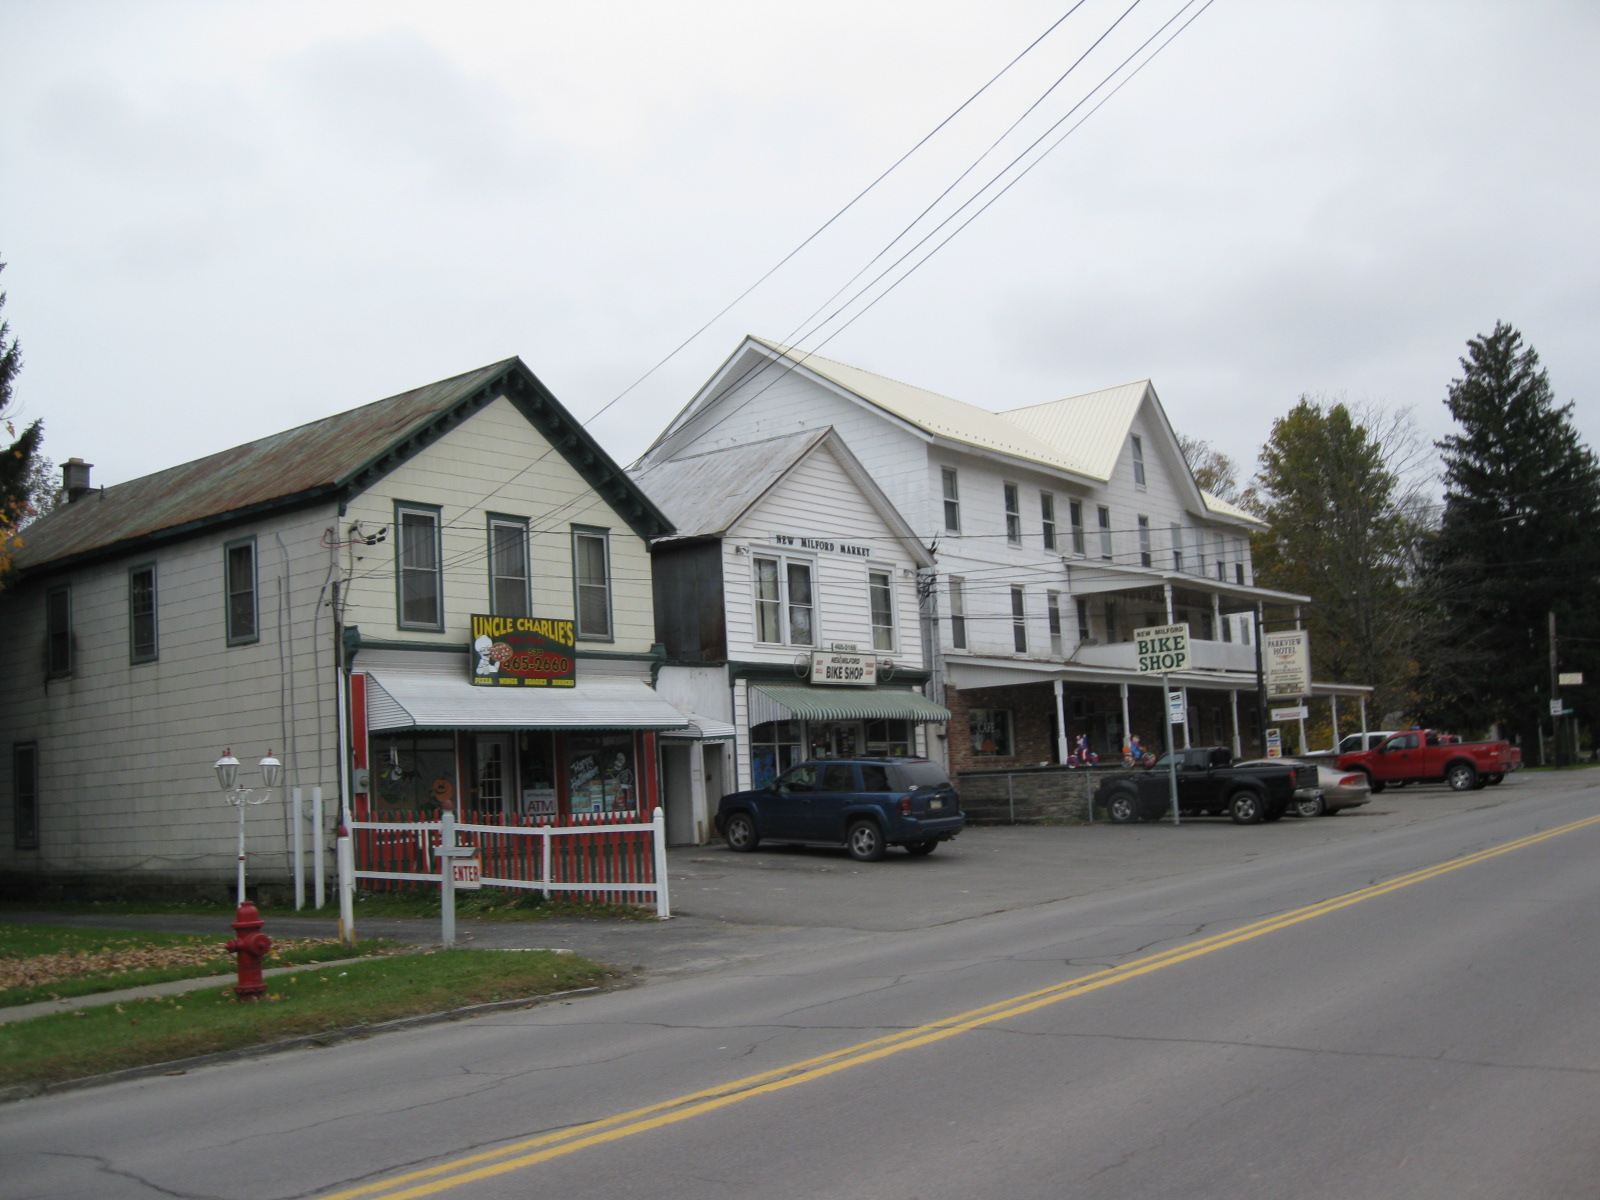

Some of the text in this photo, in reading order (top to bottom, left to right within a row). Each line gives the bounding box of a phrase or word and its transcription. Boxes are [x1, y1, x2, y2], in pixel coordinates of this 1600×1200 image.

[776, 535, 870, 557] NEW MILFORD MARKET
[473, 616, 574, 647] UNCLE CHARLIE'S
[1136, 626, 1184, 638] NEW MILFORD
[1137, 635, 1185, 655] BIKE
[1267, 638, 1302, 648] PARKVIEW
[1273, 646, 1297, 655] HOTEL
[503, 656, 569, 672] 465-2660
[1139, 653, 1186, 672] SHOP
[826, 666, 843, 679] BIKE
[845, 667, 864, 680] SHOP
[527, 800, 554, 812] ATM
[453, 865, 480, 881] ENTER
